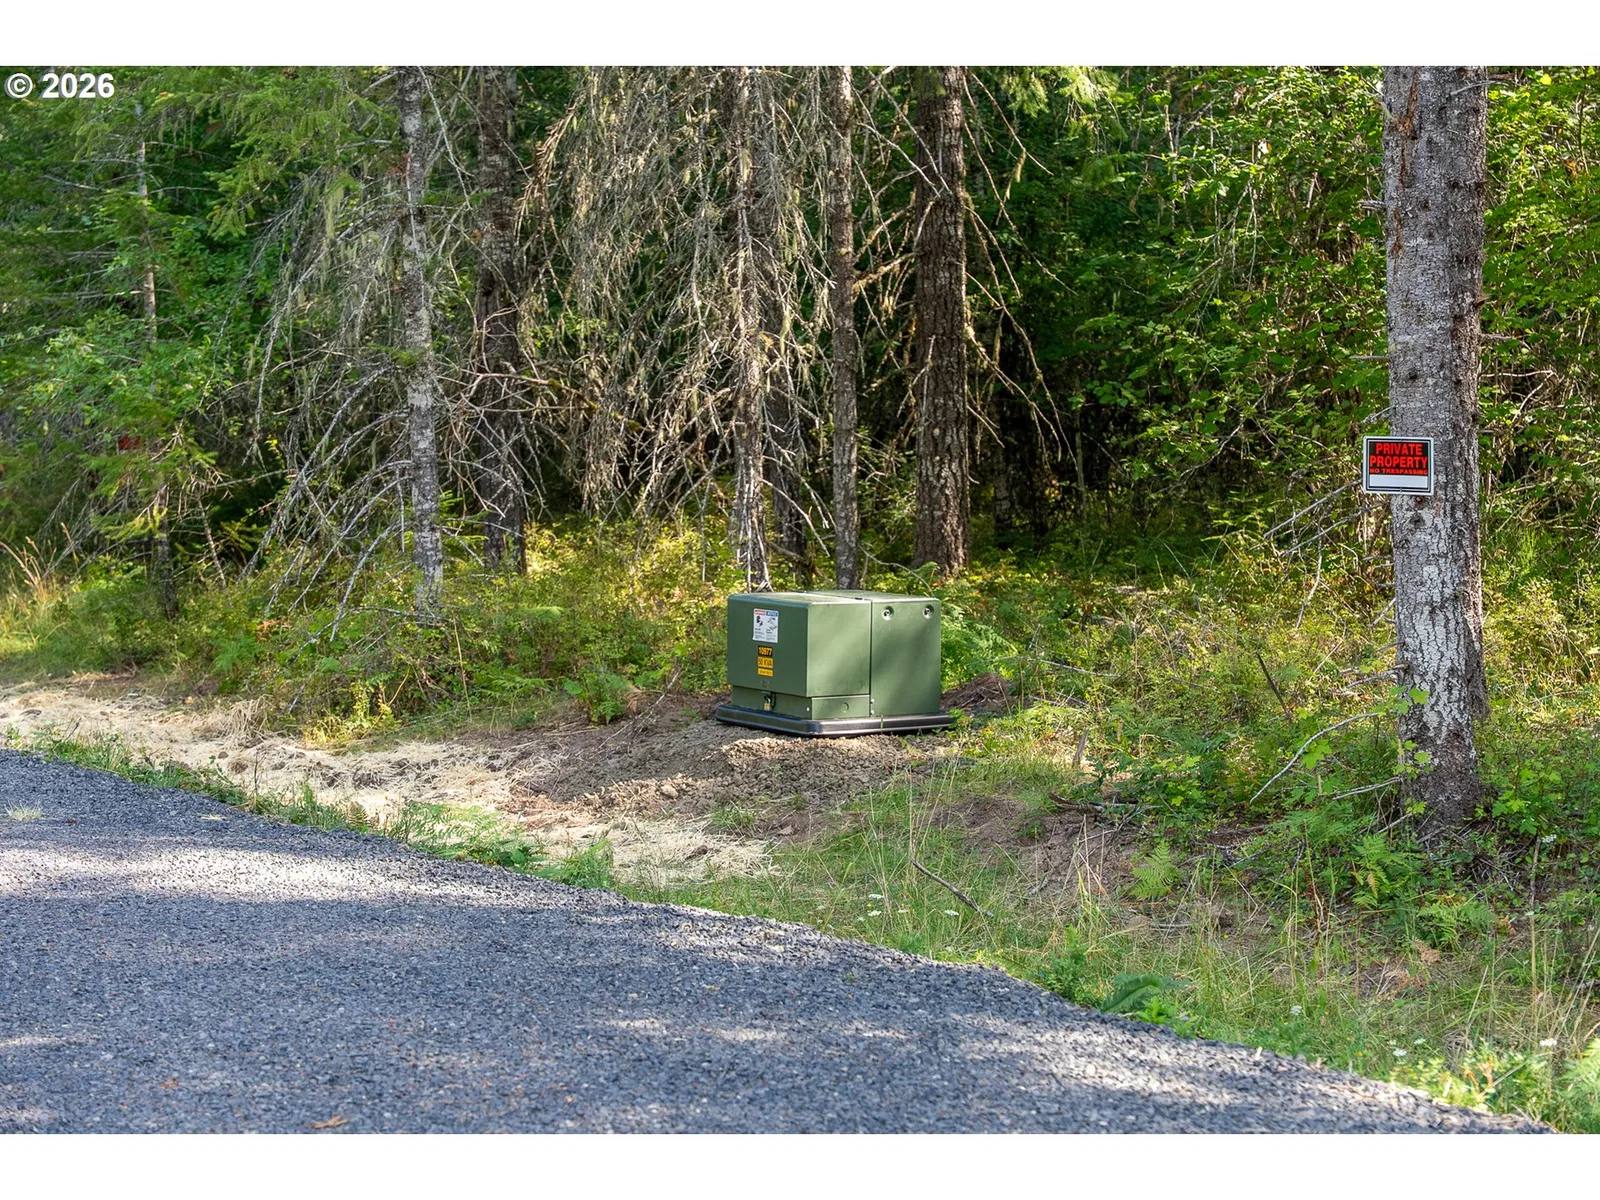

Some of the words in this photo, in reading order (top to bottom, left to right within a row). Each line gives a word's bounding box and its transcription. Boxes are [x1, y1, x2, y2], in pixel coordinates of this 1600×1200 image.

[1376, 443, 1423, 455] PRIVATE
[1370, 455, 1428, 468] PROPERTY
[764, 658, 772, 667] KVA
